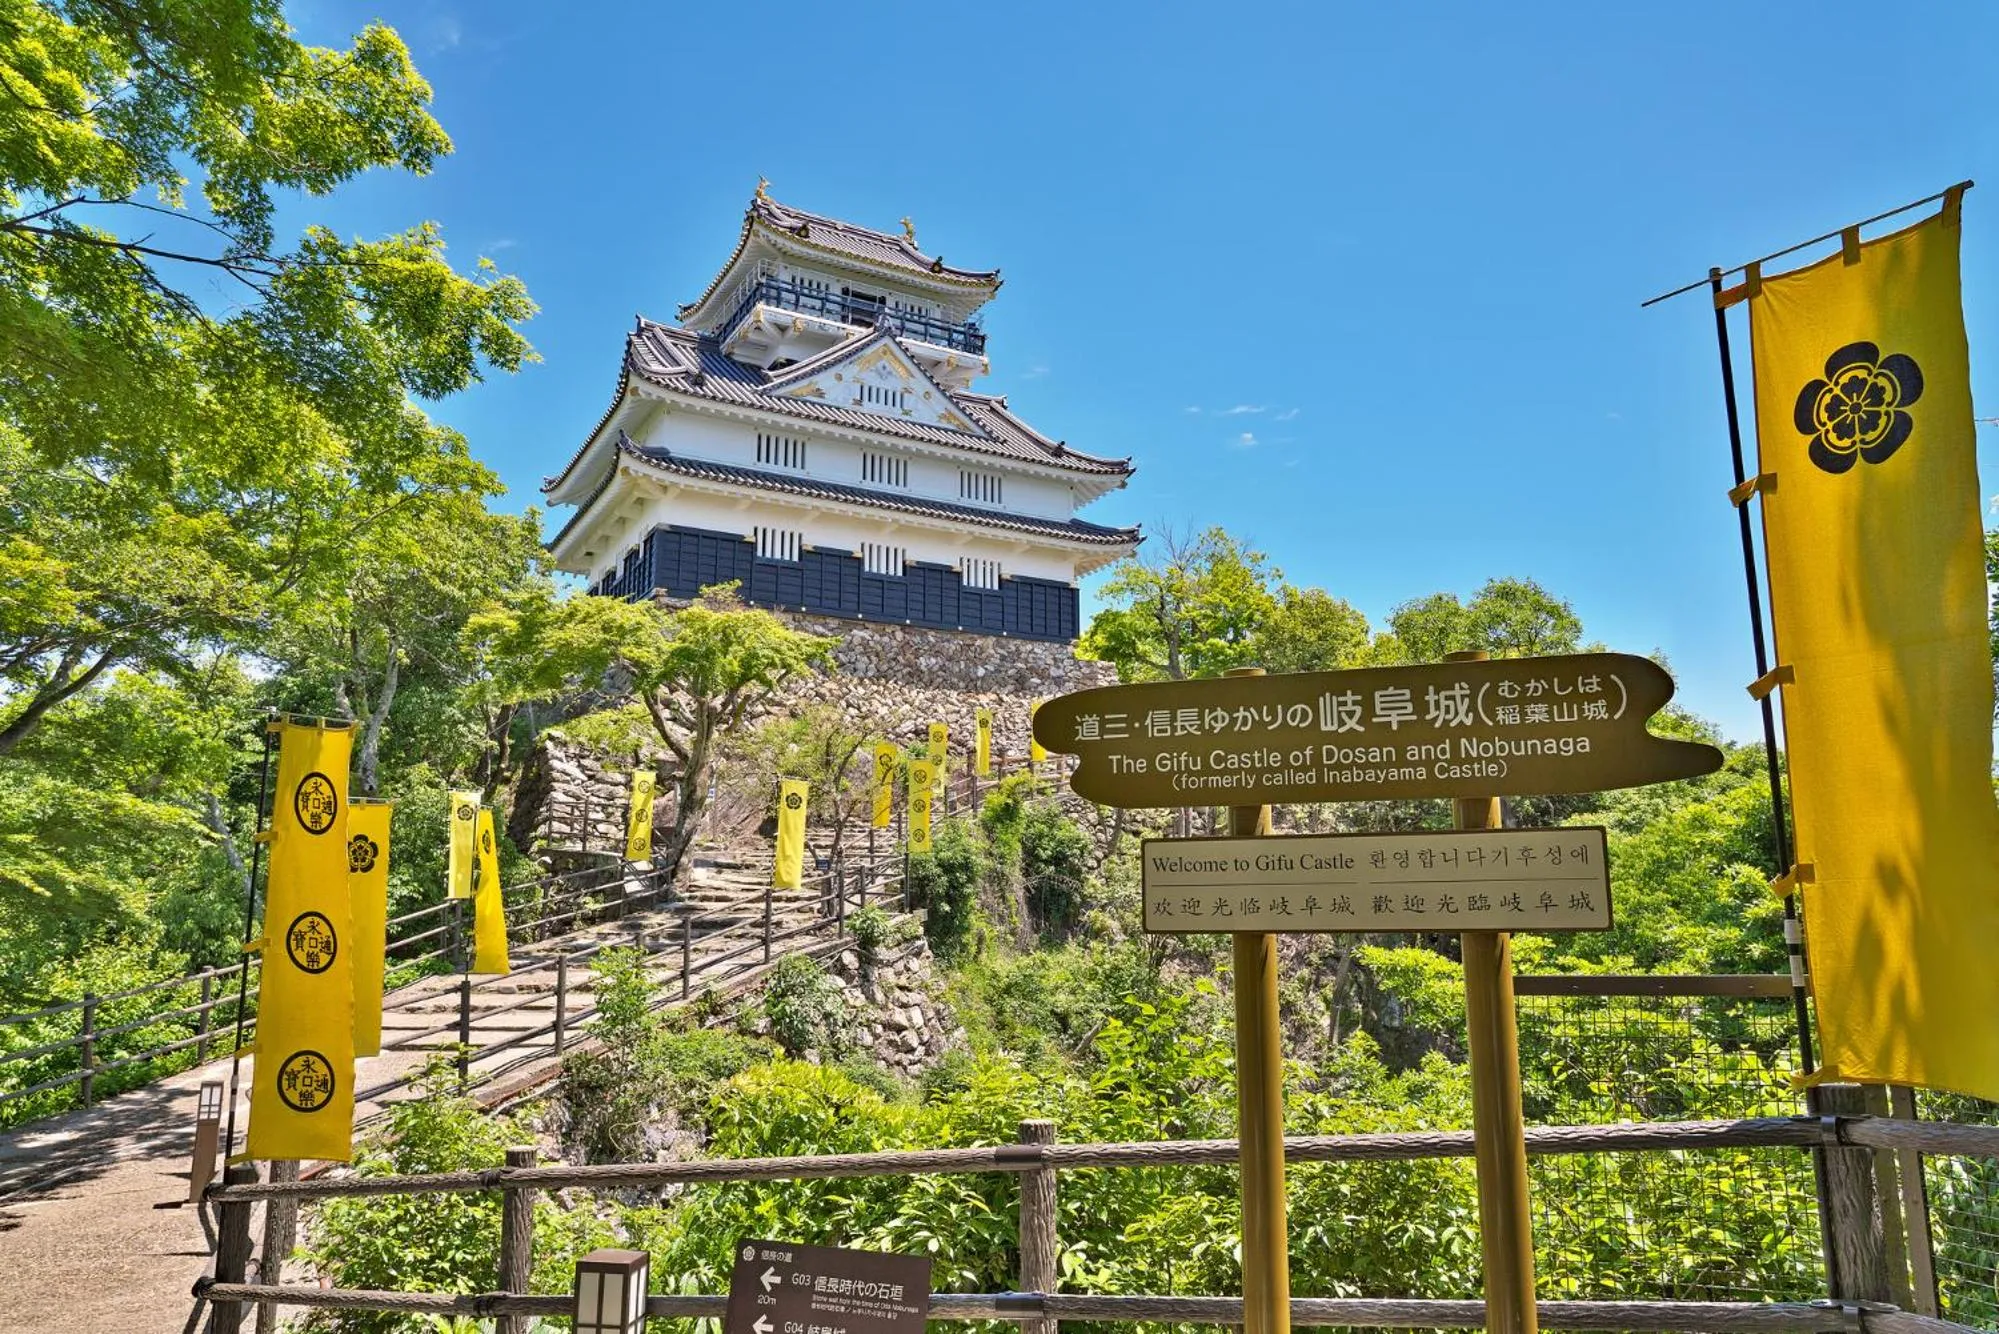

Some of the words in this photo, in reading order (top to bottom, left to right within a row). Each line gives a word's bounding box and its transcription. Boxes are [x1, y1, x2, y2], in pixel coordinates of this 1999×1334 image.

[1499, 676, 1601, 697] むかしは
[1496, 700, 1608, 725] 稲葉山城
[1109, 755, 1146, 773] The
[1156, 752, 1201, 771] Gifu
[1210, 748, 1281, 769] Castle
[1290, 746, 1313, 766] of
[1323, 745, 1395, 764] Dosan
[1407, 739, 1450, 760] and
[1461, 737, 1590, 758] Nobunaga
[1173, 771, 1255, 791] (formerly
[1263, 768, 1315, 785] called
[1325, 766, 1426, 783] Inabayama
[1435, 760, 1507, 778] Castle)
[1153, 857, 1228, 872] Welcome
[1234, 859, 1249, 871] to
[1256, 855, 1293, 871] Gifu
[1300, 853, 1354, 870] Castle
[1153, 895, 1354, 916] 欢迎光临岐阜城
[1373, 891, 1594, 914] 歡迎光臨岐阜城
[792, 1273, 810, 1286] G03
[814, 1277, 903, 1300] 信長時代の石垣
[758, 1295, 776, 1304] 20m
